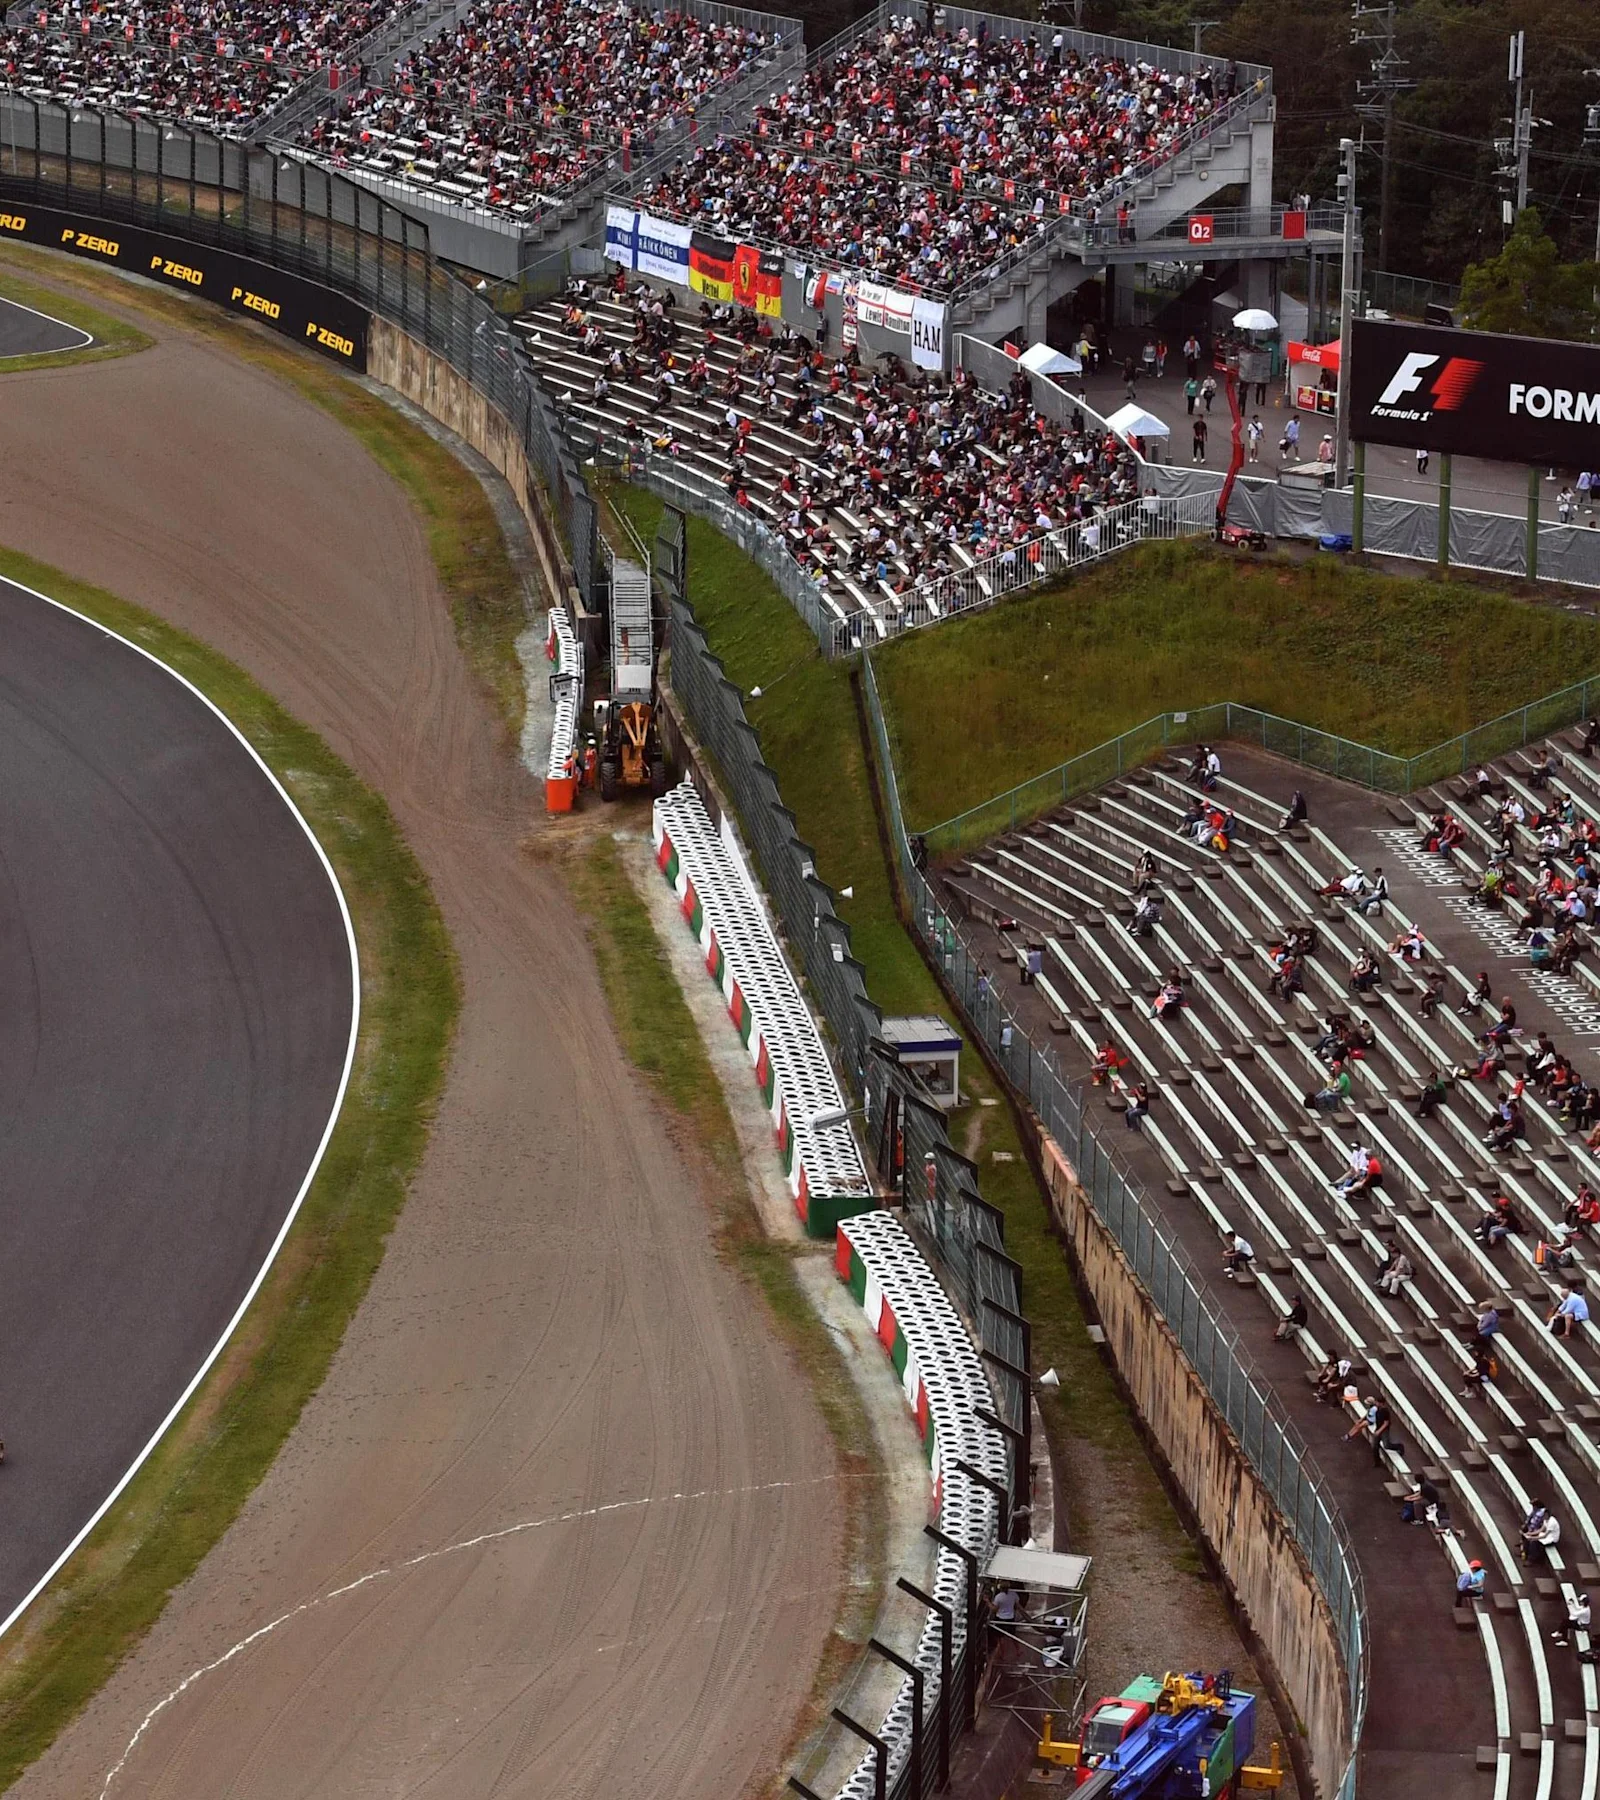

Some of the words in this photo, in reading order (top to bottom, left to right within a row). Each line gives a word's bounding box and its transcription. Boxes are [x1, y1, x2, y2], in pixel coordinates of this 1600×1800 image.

[61, 229, 74, 242] P
[76, 233, 119, 256] ZERO
[1191, 223, 1210, 239] Q2
[151, 256, 163, 269] P
[163, 260, 203, 285] ZERO
[231, 287, 243, 300] P
[243, 292, 281, 319] ZERO
[306, 322, 318, 336] P
[317, 328, 354, 356] ZERO
[914, 320, 941, 353] HAM
[1370, 404, 1420, 421] Formula
